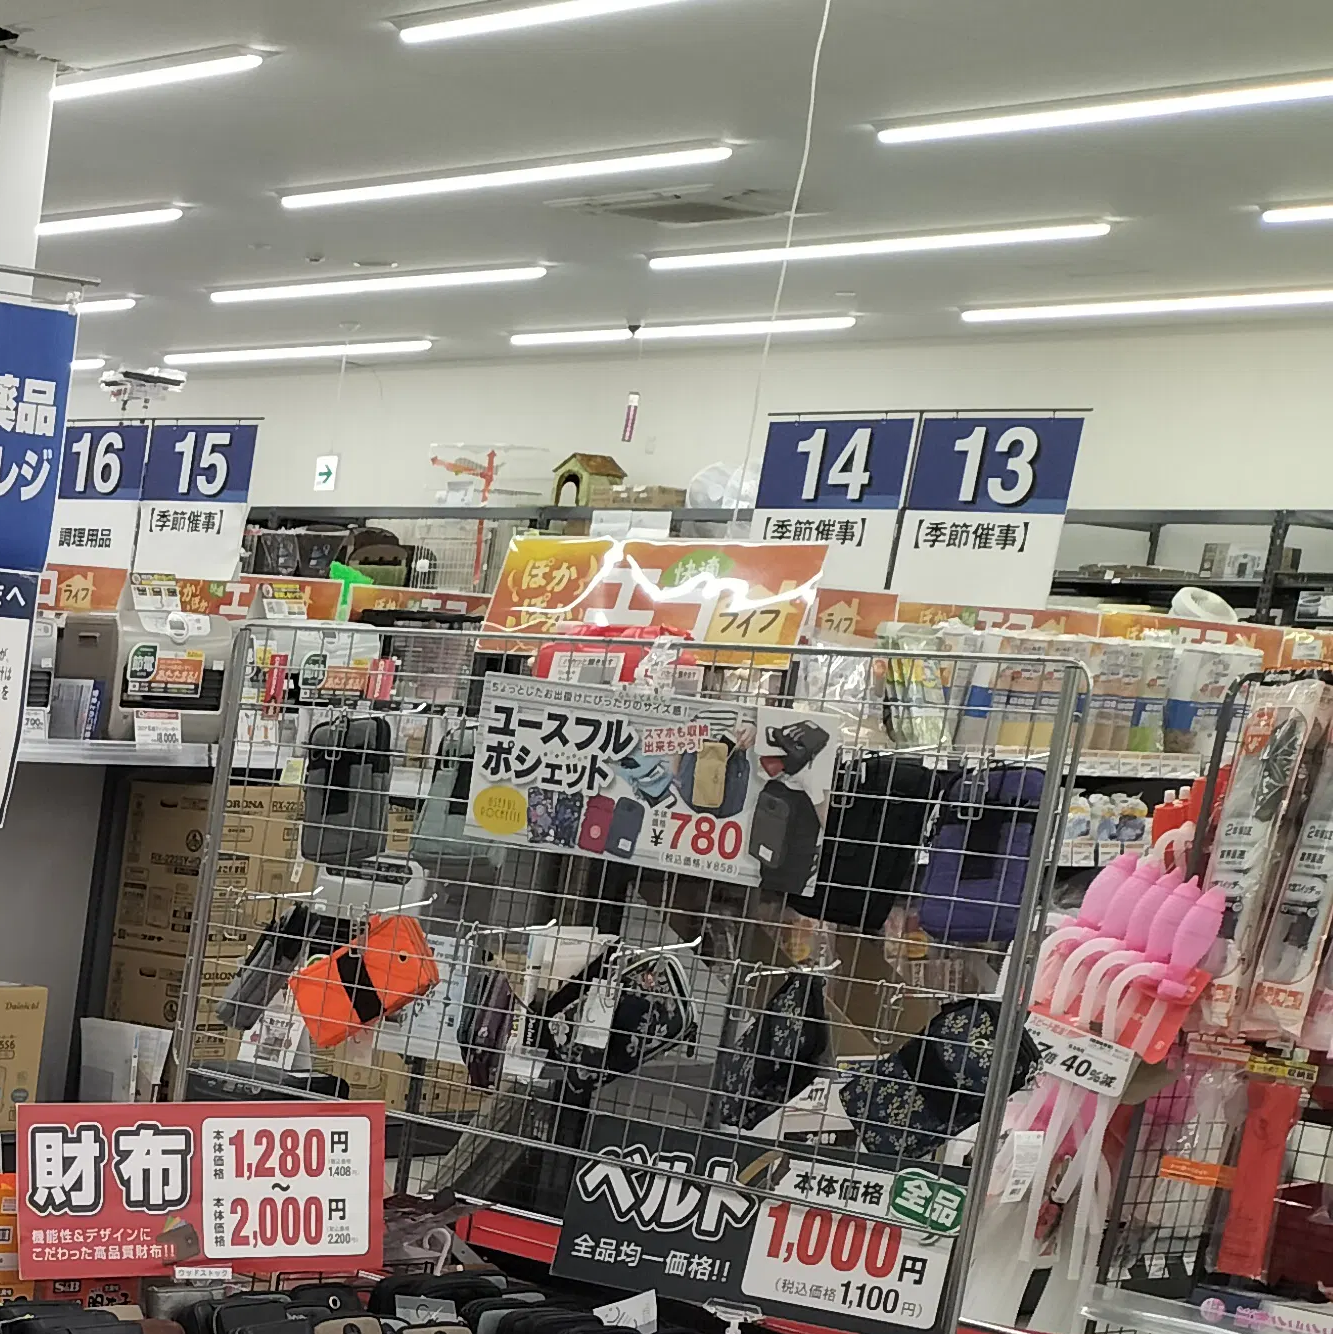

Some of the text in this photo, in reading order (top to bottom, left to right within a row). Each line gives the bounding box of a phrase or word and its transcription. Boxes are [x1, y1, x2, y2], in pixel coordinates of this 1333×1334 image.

[71, 430, 123, 494] 16
[173, 431, 231, 496] 15
[795, 427, 872, 501] 14
[953, 426, 1039, 506] 13
[58, 526, 112, 549] 調理用品
[485, 704, 635, 756] ユースフル
[642, 737, 706, 755] 出来ちゃう!
[643, 722, 710, 741] スマホも収納
[482, 741, 614, 791] ポシェット
[223, 800, 264, 809] ORONA
[30, 1123, 190, 1212] 財布
[212, 1130, 225, 1180] 本体価格
[580, 1147, 755, 1238] ベルト
[794, 1170, 884, 1206] 本体価格
[897, 1177, 959, 1224] 全品
[31, 1228, 151, 1245] 機能性&デザインに
[213, 1198, 225, 1247] 本体価格
[765, 1200, 929, 1285] 1,000円
[31, 1244, 176, 1261] こだわった高品質財布!!
[571, 1233, 730, 1284] 全品均一価格!!
[53, 1281, 81, 1293] S&B
